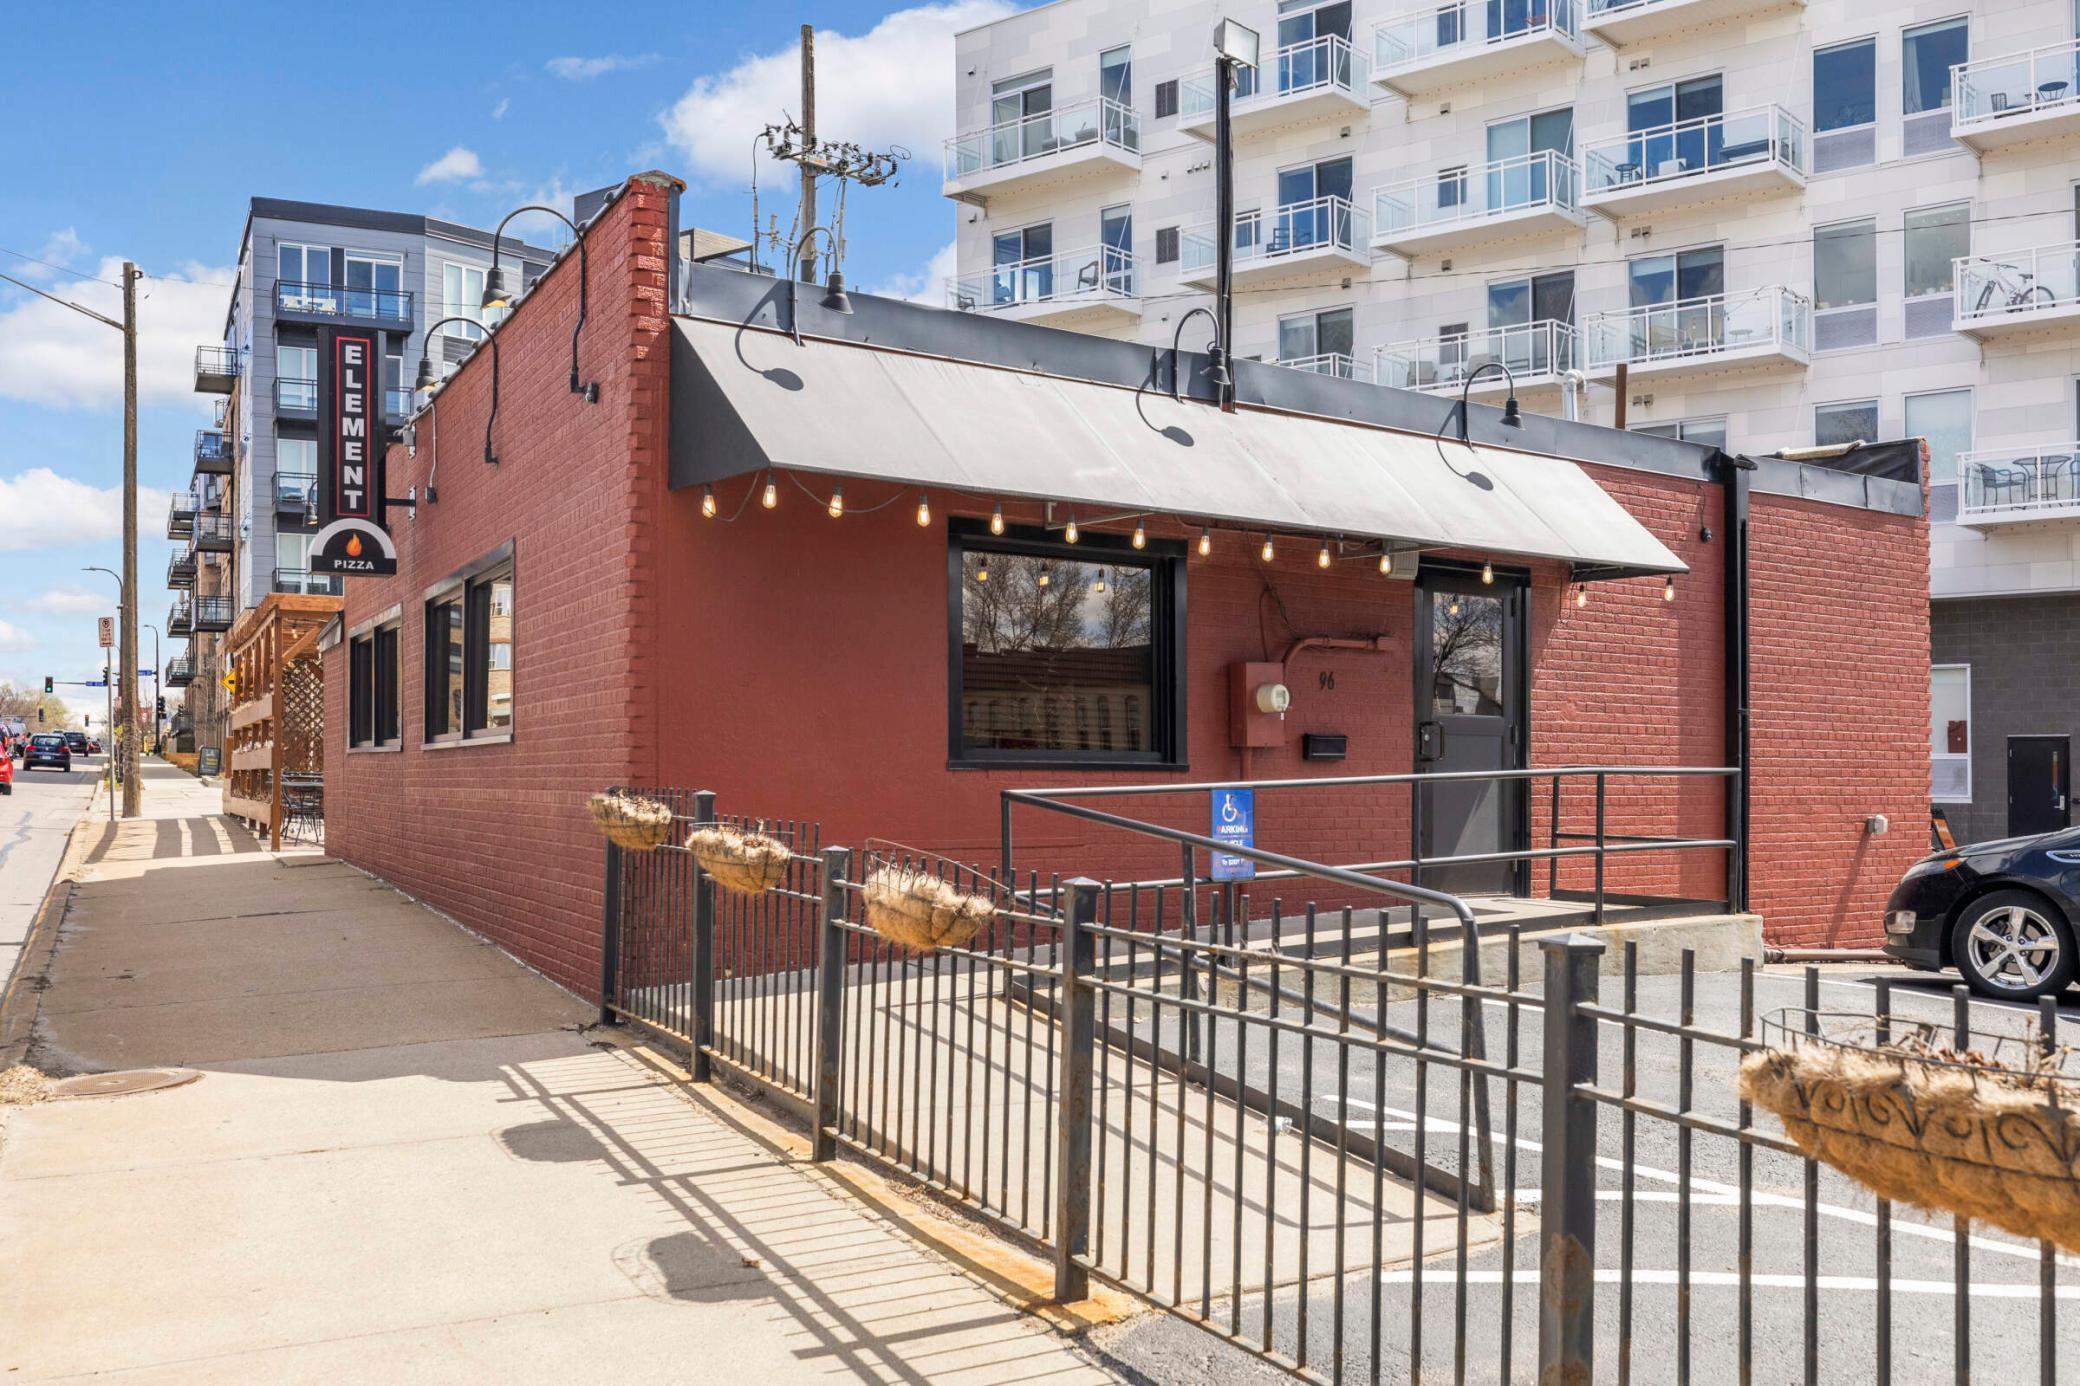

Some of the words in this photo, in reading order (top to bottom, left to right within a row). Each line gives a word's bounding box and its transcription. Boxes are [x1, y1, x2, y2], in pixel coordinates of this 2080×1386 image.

[342, 344, 364, 510] ELEMENT
[334, 559, 375, 570] PIZZA
[1319, 671, 1335, 690] 96
